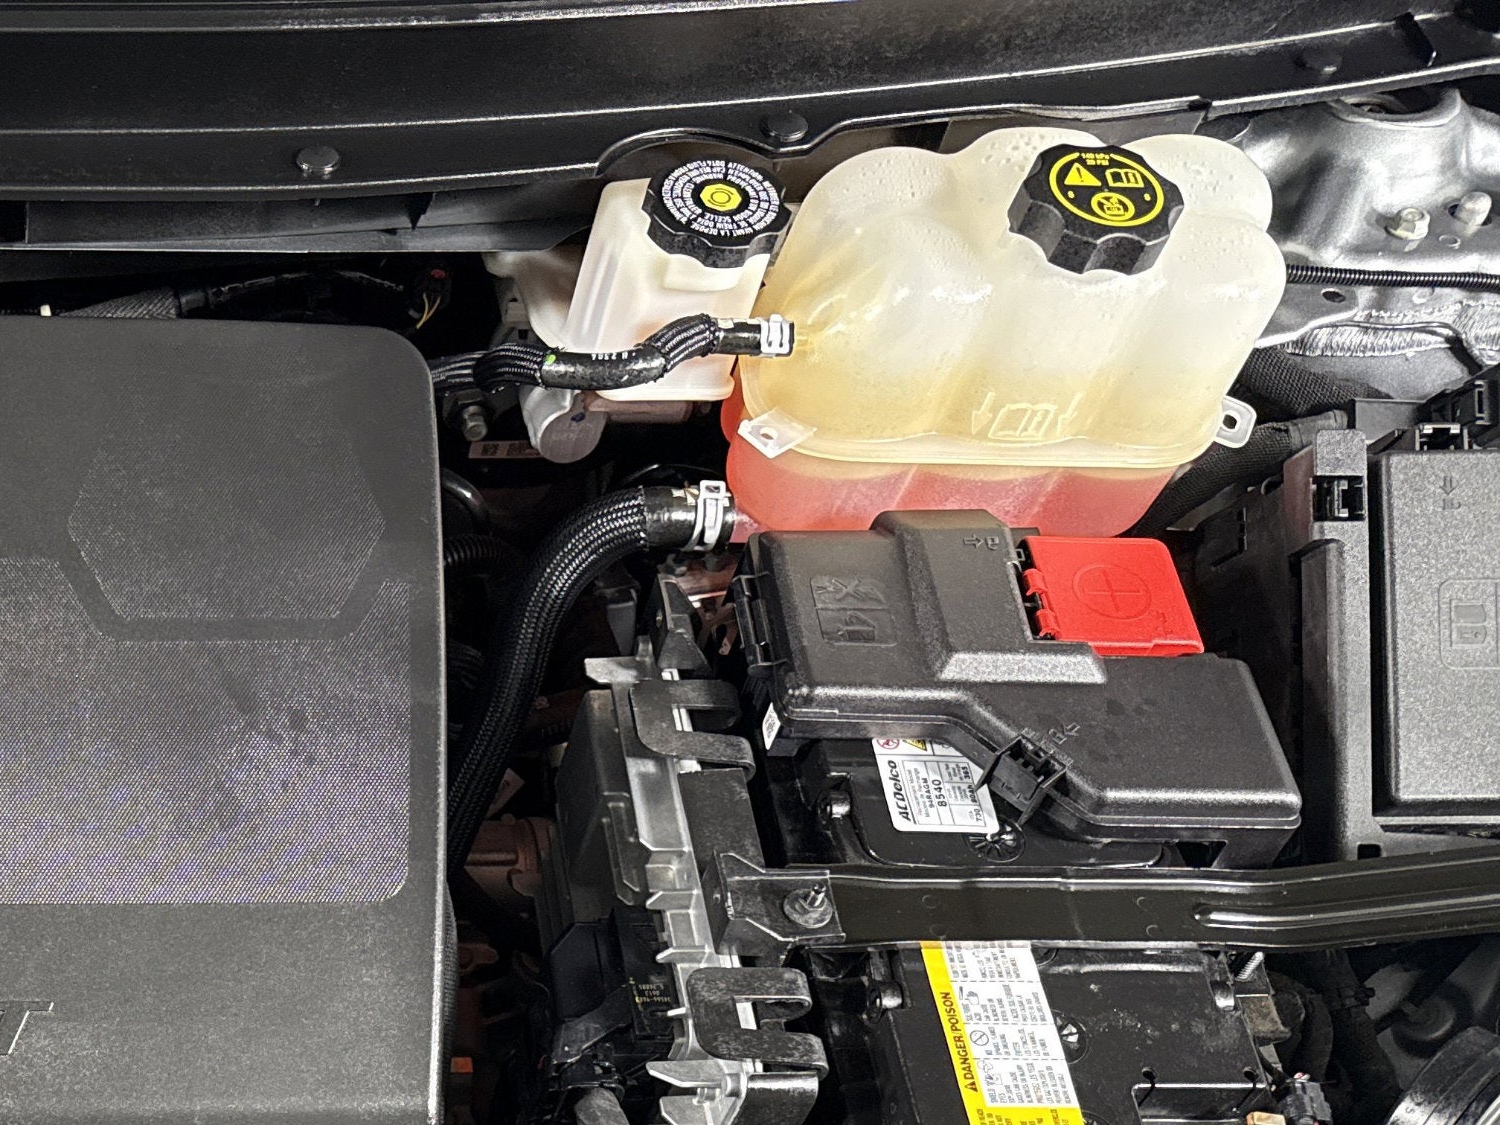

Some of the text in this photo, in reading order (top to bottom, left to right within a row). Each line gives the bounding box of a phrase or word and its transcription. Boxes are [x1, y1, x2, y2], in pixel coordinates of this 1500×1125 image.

[888, 760, 911, 822] ACDelco
[932, 779, 947, 807] 8540
[940, 992, 976, 1080] DANGER/POISON
